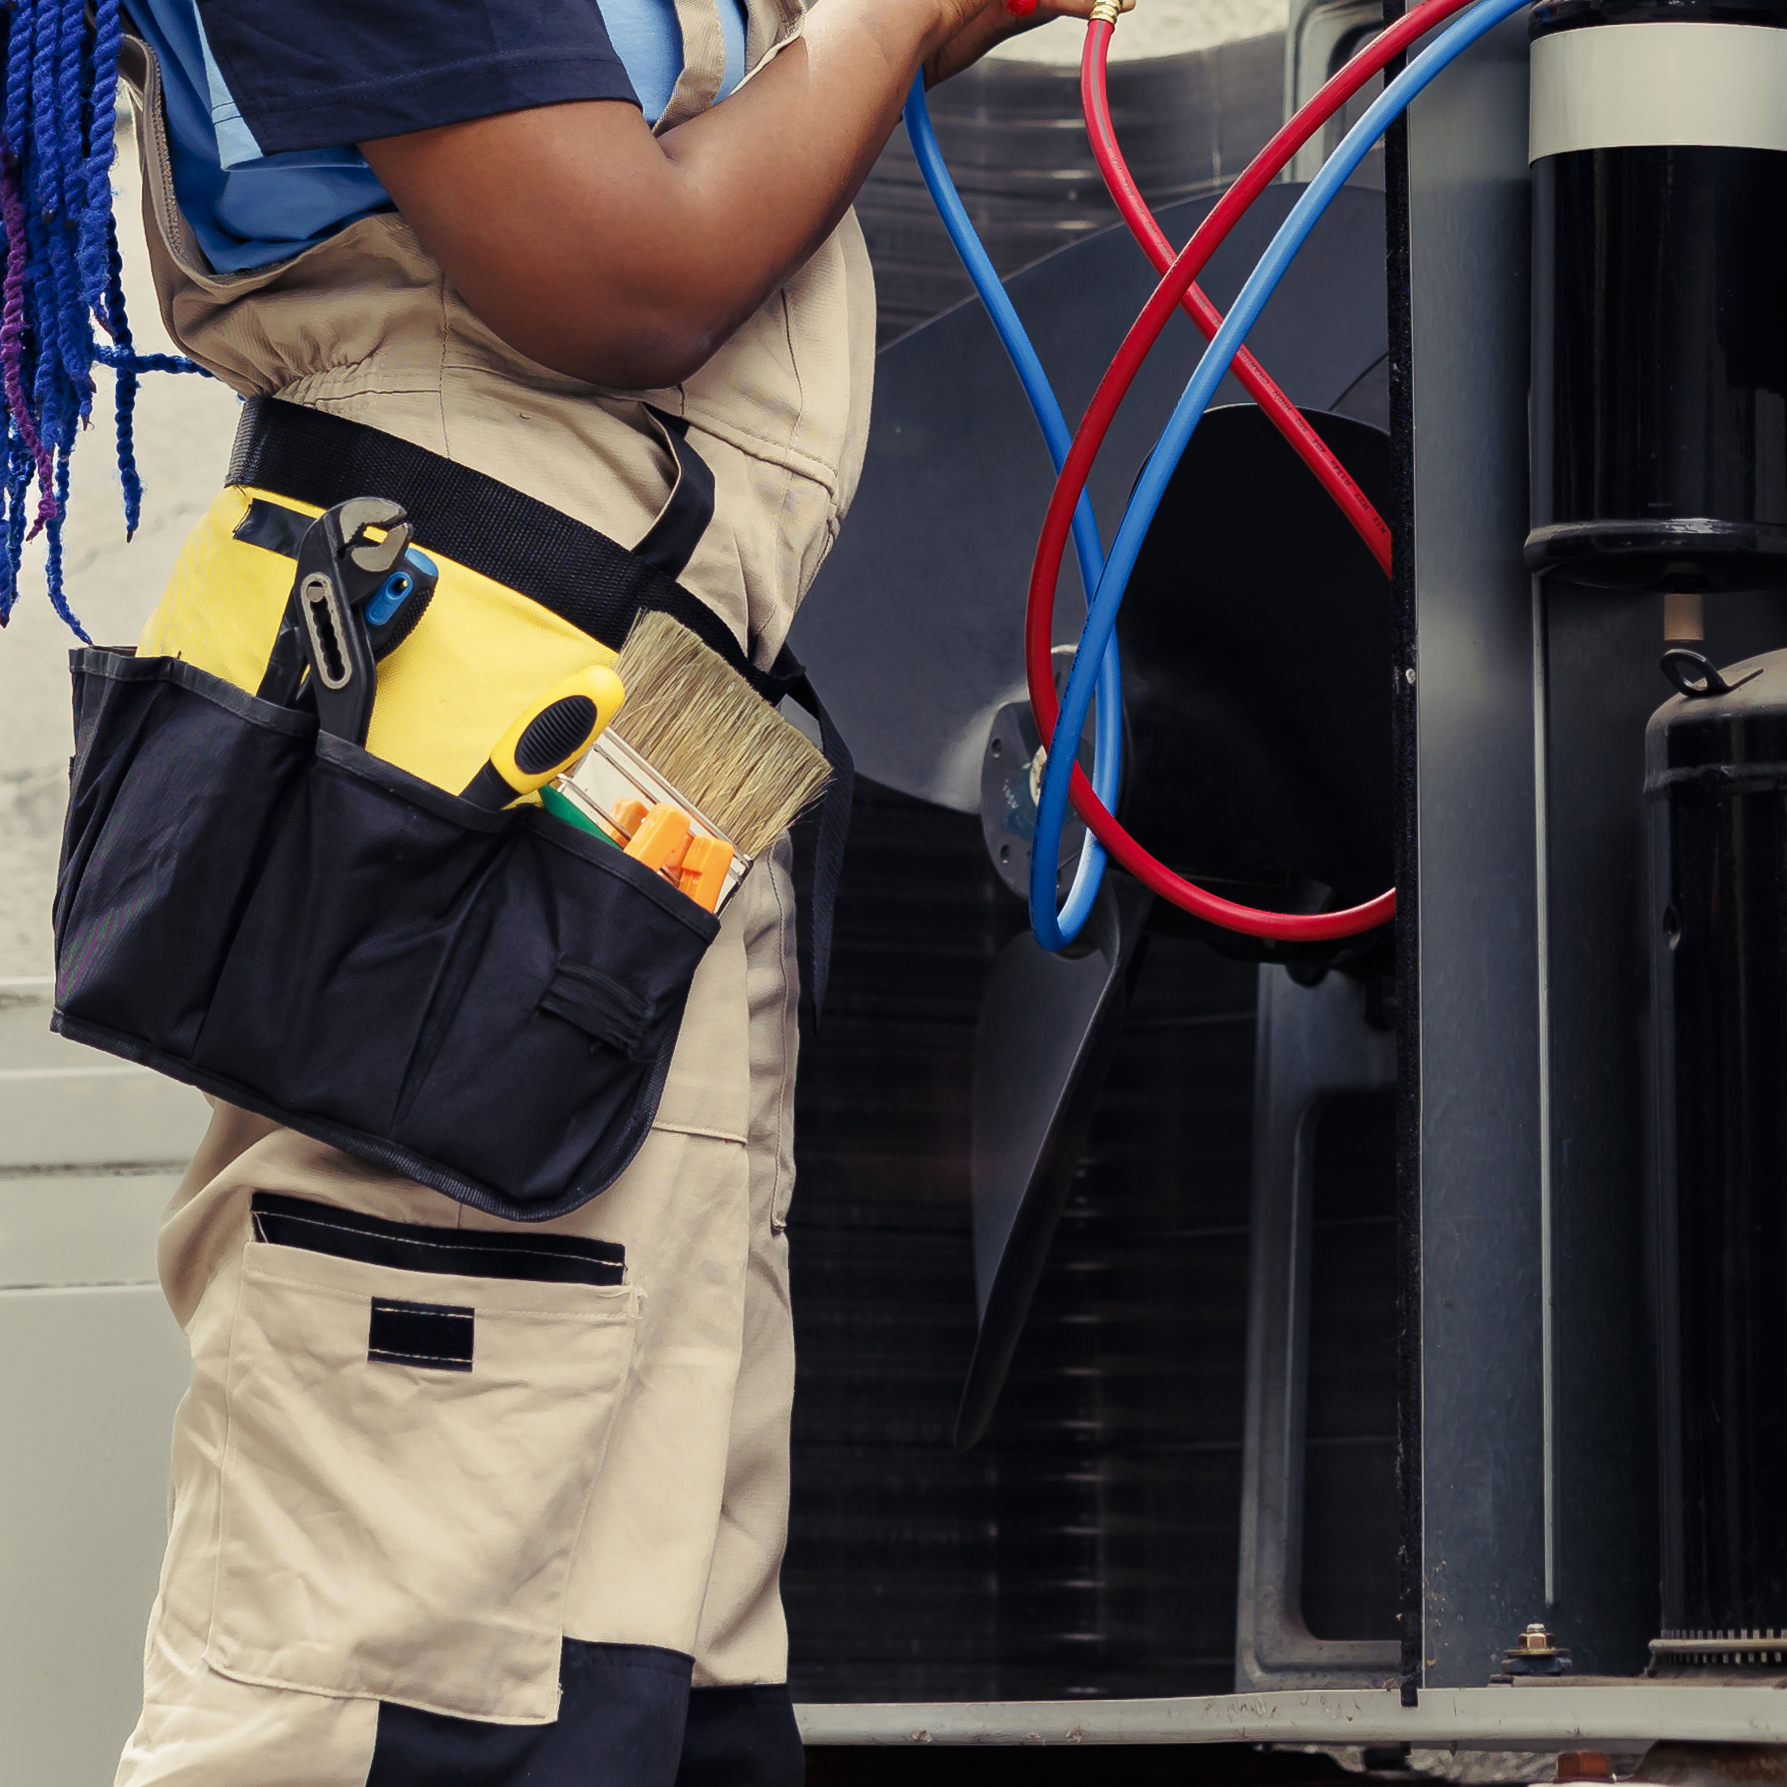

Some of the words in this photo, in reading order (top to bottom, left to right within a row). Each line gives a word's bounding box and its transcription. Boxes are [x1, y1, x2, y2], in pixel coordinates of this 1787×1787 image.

[1238, 348, 1270, 386] CHARGIN
[1330, 460, 1352, 487] R134a
[1354, 493, 1370, 511] R22
[1372, 516, 1388, 535] R12
